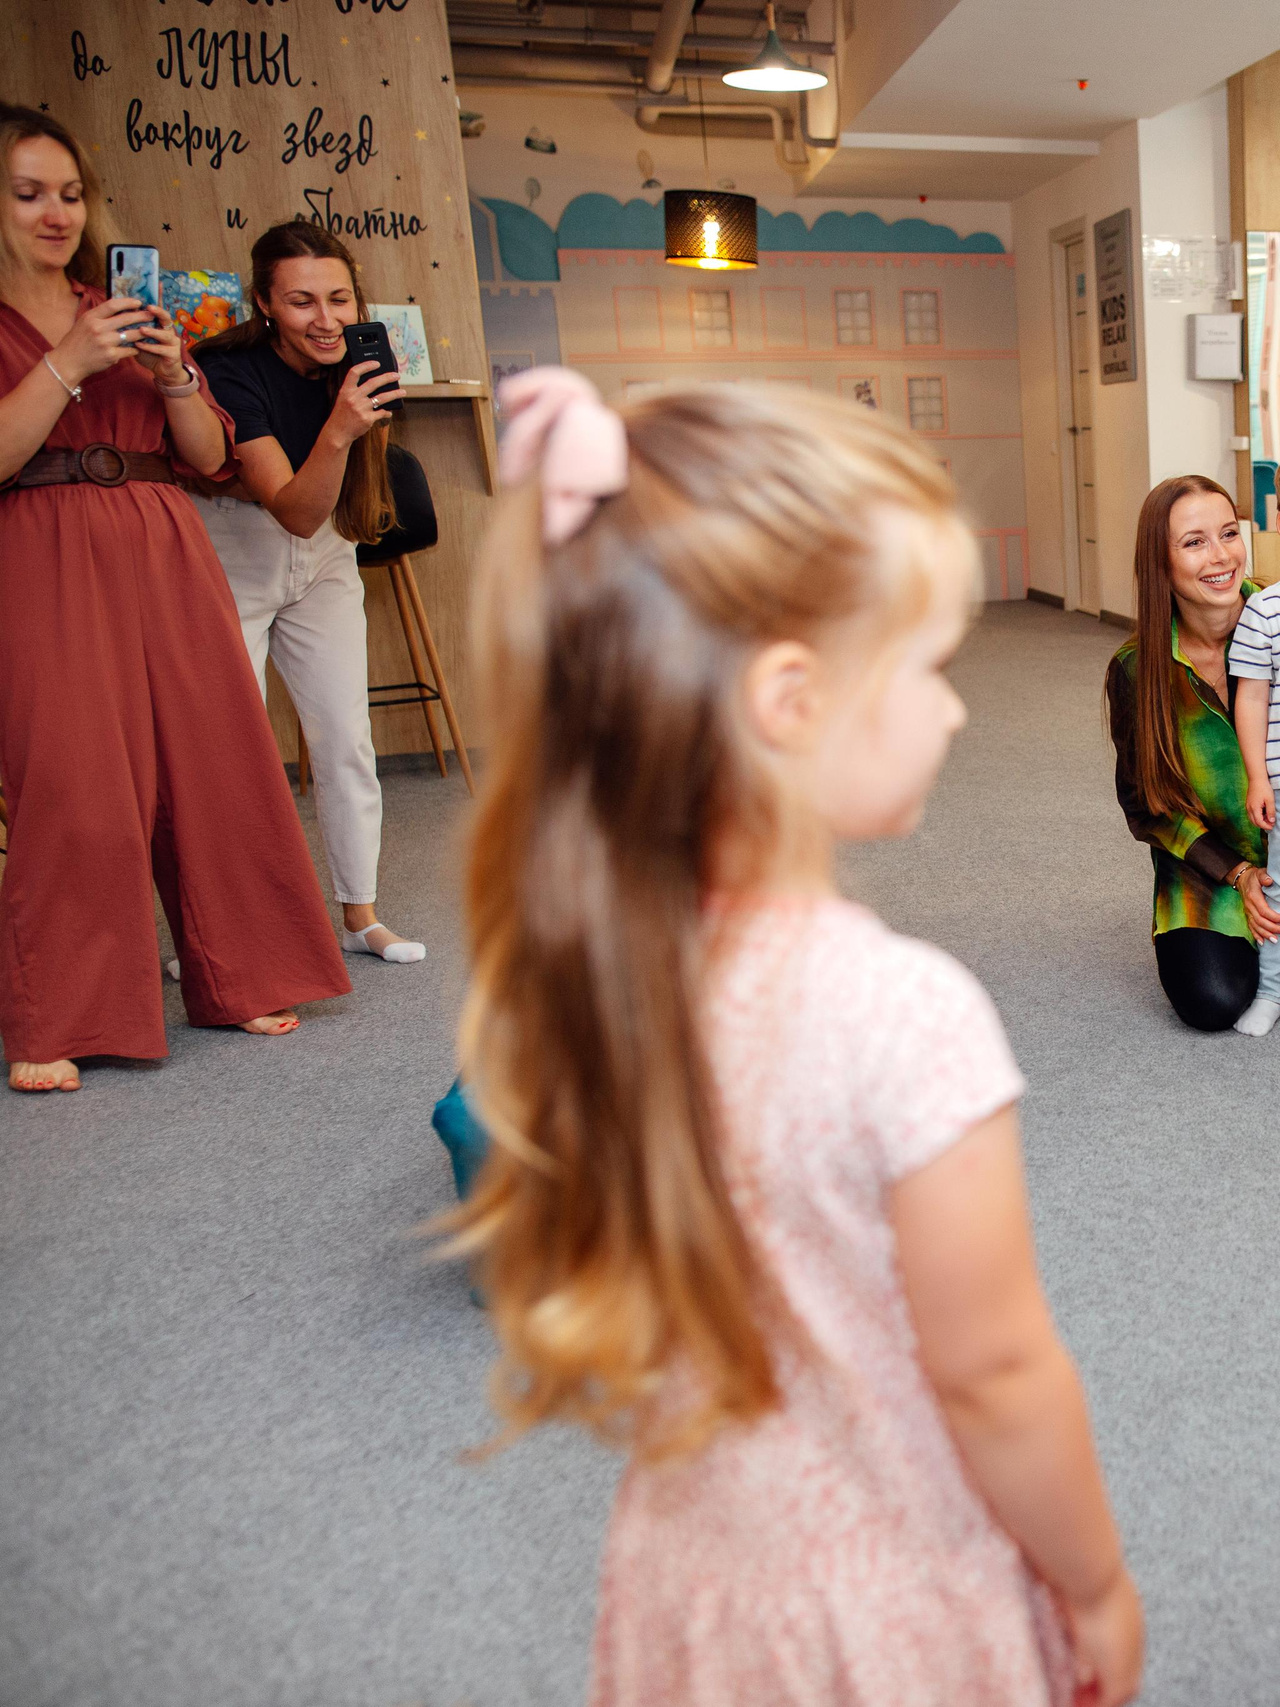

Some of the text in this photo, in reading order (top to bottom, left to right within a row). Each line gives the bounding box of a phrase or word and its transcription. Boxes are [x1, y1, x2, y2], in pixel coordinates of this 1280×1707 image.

[156, 27, 302, 91] ЛУНЫ
[280, 106, 379, 175] звезд
[226, 207, 249, 230] и
